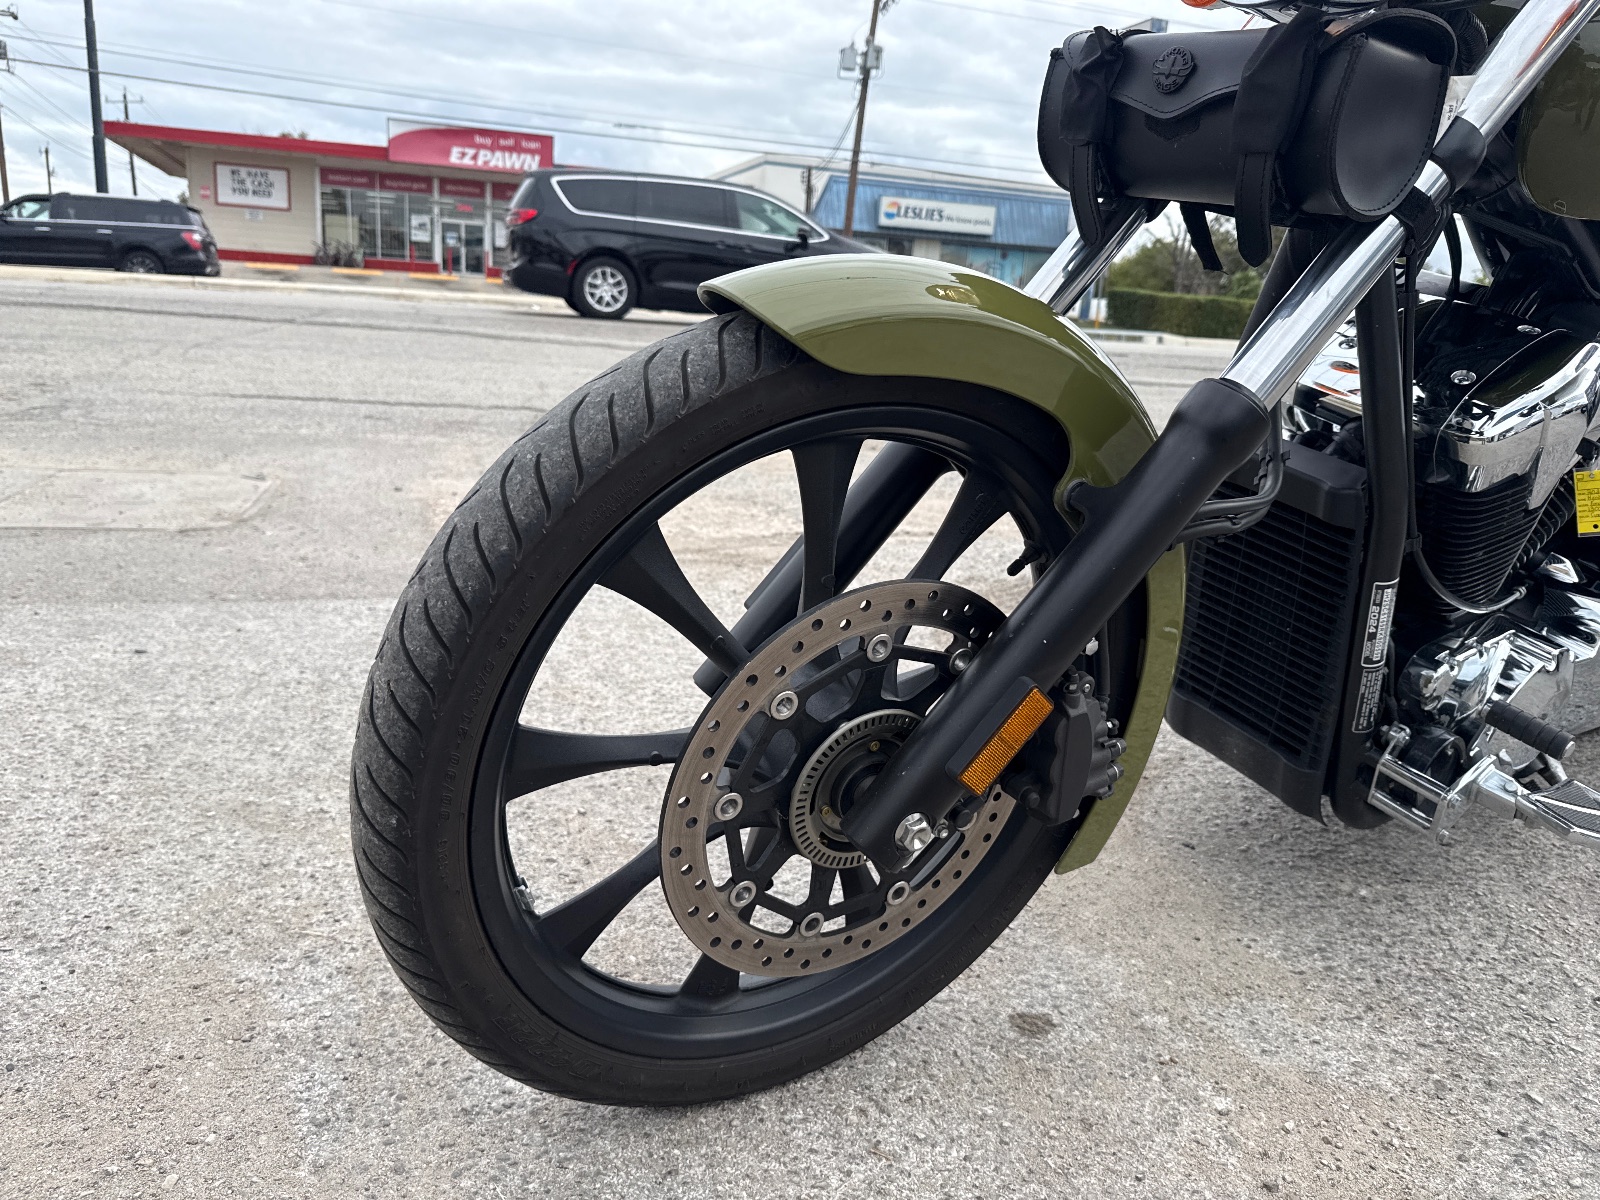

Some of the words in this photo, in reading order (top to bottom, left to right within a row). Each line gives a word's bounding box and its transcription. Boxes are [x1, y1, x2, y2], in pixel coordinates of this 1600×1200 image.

[449, 145, 541, 172] EZPAWN
[230, 168, 241, 177] WE
[231, 187, 250, 196] YOU
[251, 189, 274, 198] NEED
[1368, 605, 1380, 632] 2024
